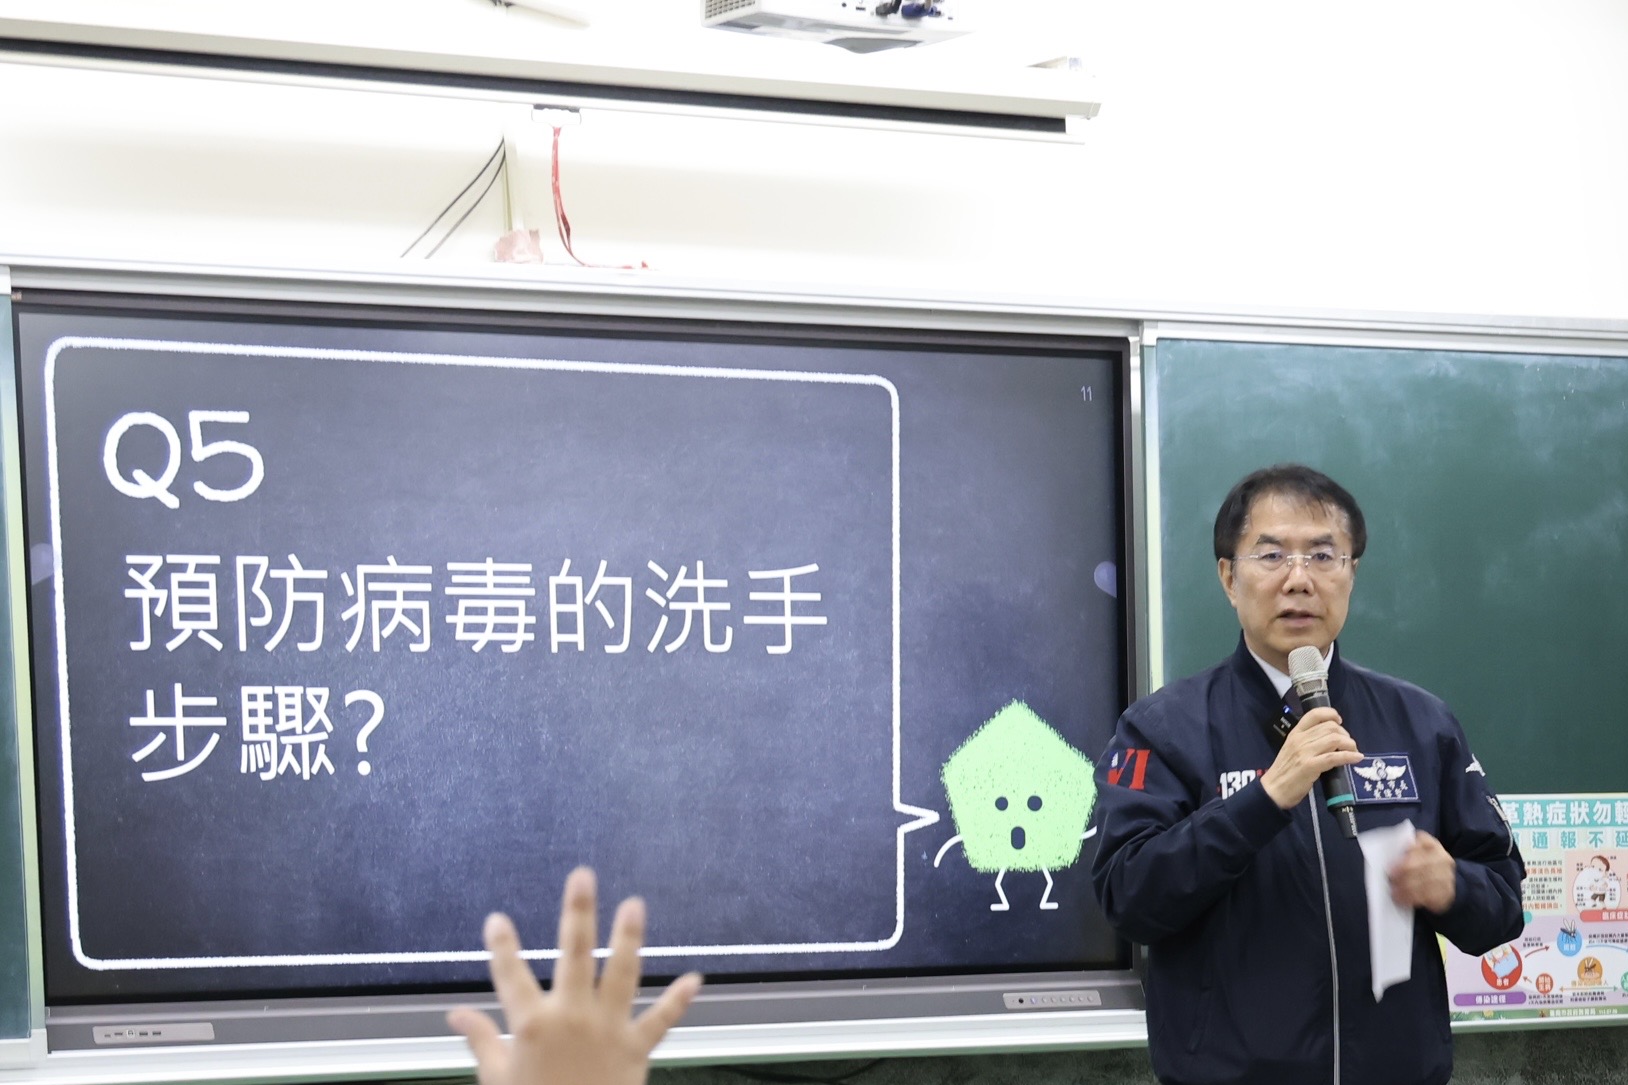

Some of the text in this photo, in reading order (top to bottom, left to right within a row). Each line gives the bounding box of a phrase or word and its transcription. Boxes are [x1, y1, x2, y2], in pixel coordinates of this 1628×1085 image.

[103, 409, 265, 508] Q5
[124, 553, 828, 655] 預防病毒的洗手
[129, 683, 386, 782] 步驟?
